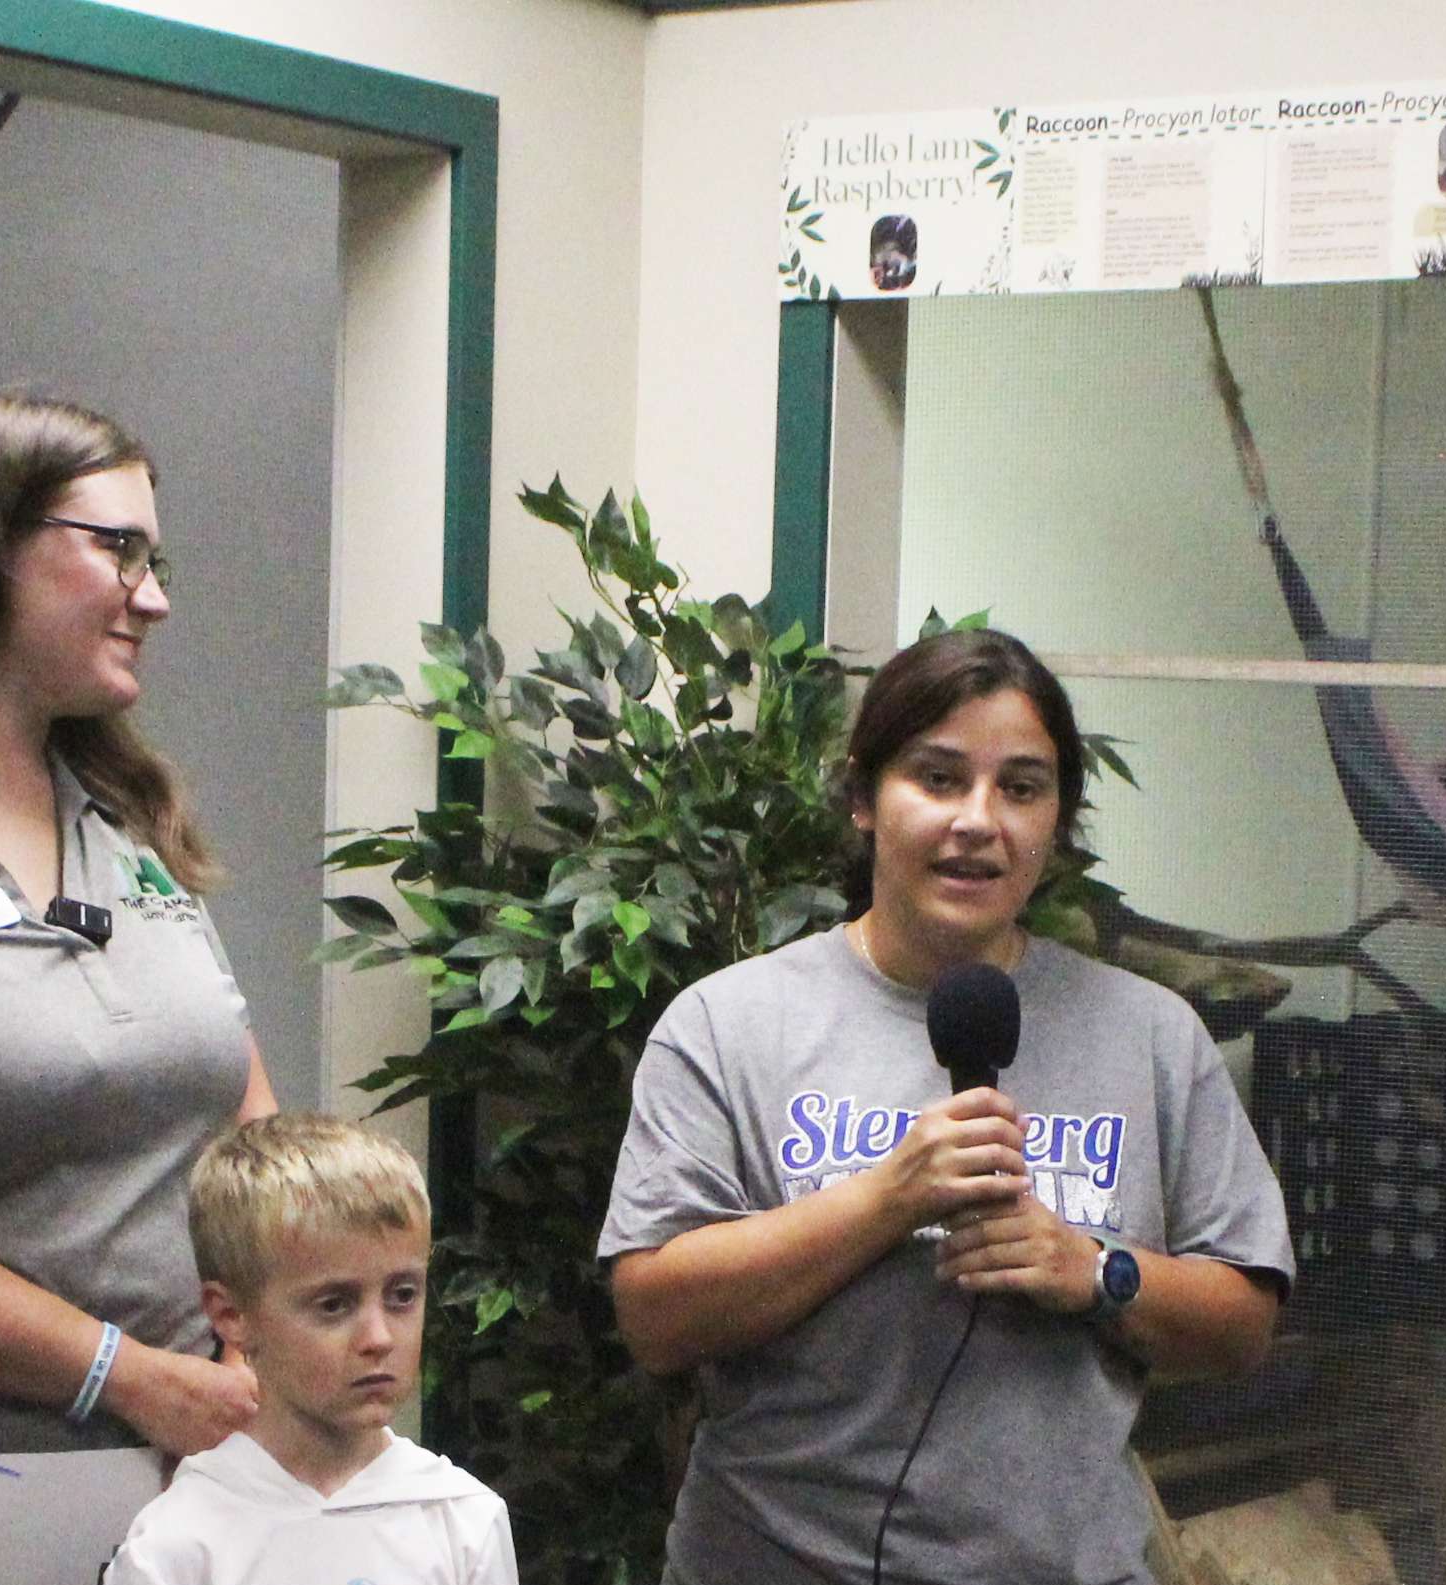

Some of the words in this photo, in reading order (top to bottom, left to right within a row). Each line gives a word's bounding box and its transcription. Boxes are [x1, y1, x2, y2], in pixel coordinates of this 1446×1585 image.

[1210, 103, 1262, 124] lotor
[821, 132, 899, 167] Hello
[906, 133, 915, 164] I
[923, 137, 971, 162] am
[813, 168, 977, 212] Raspberry!
[781, 1090, 1127, 1190] Stererg
